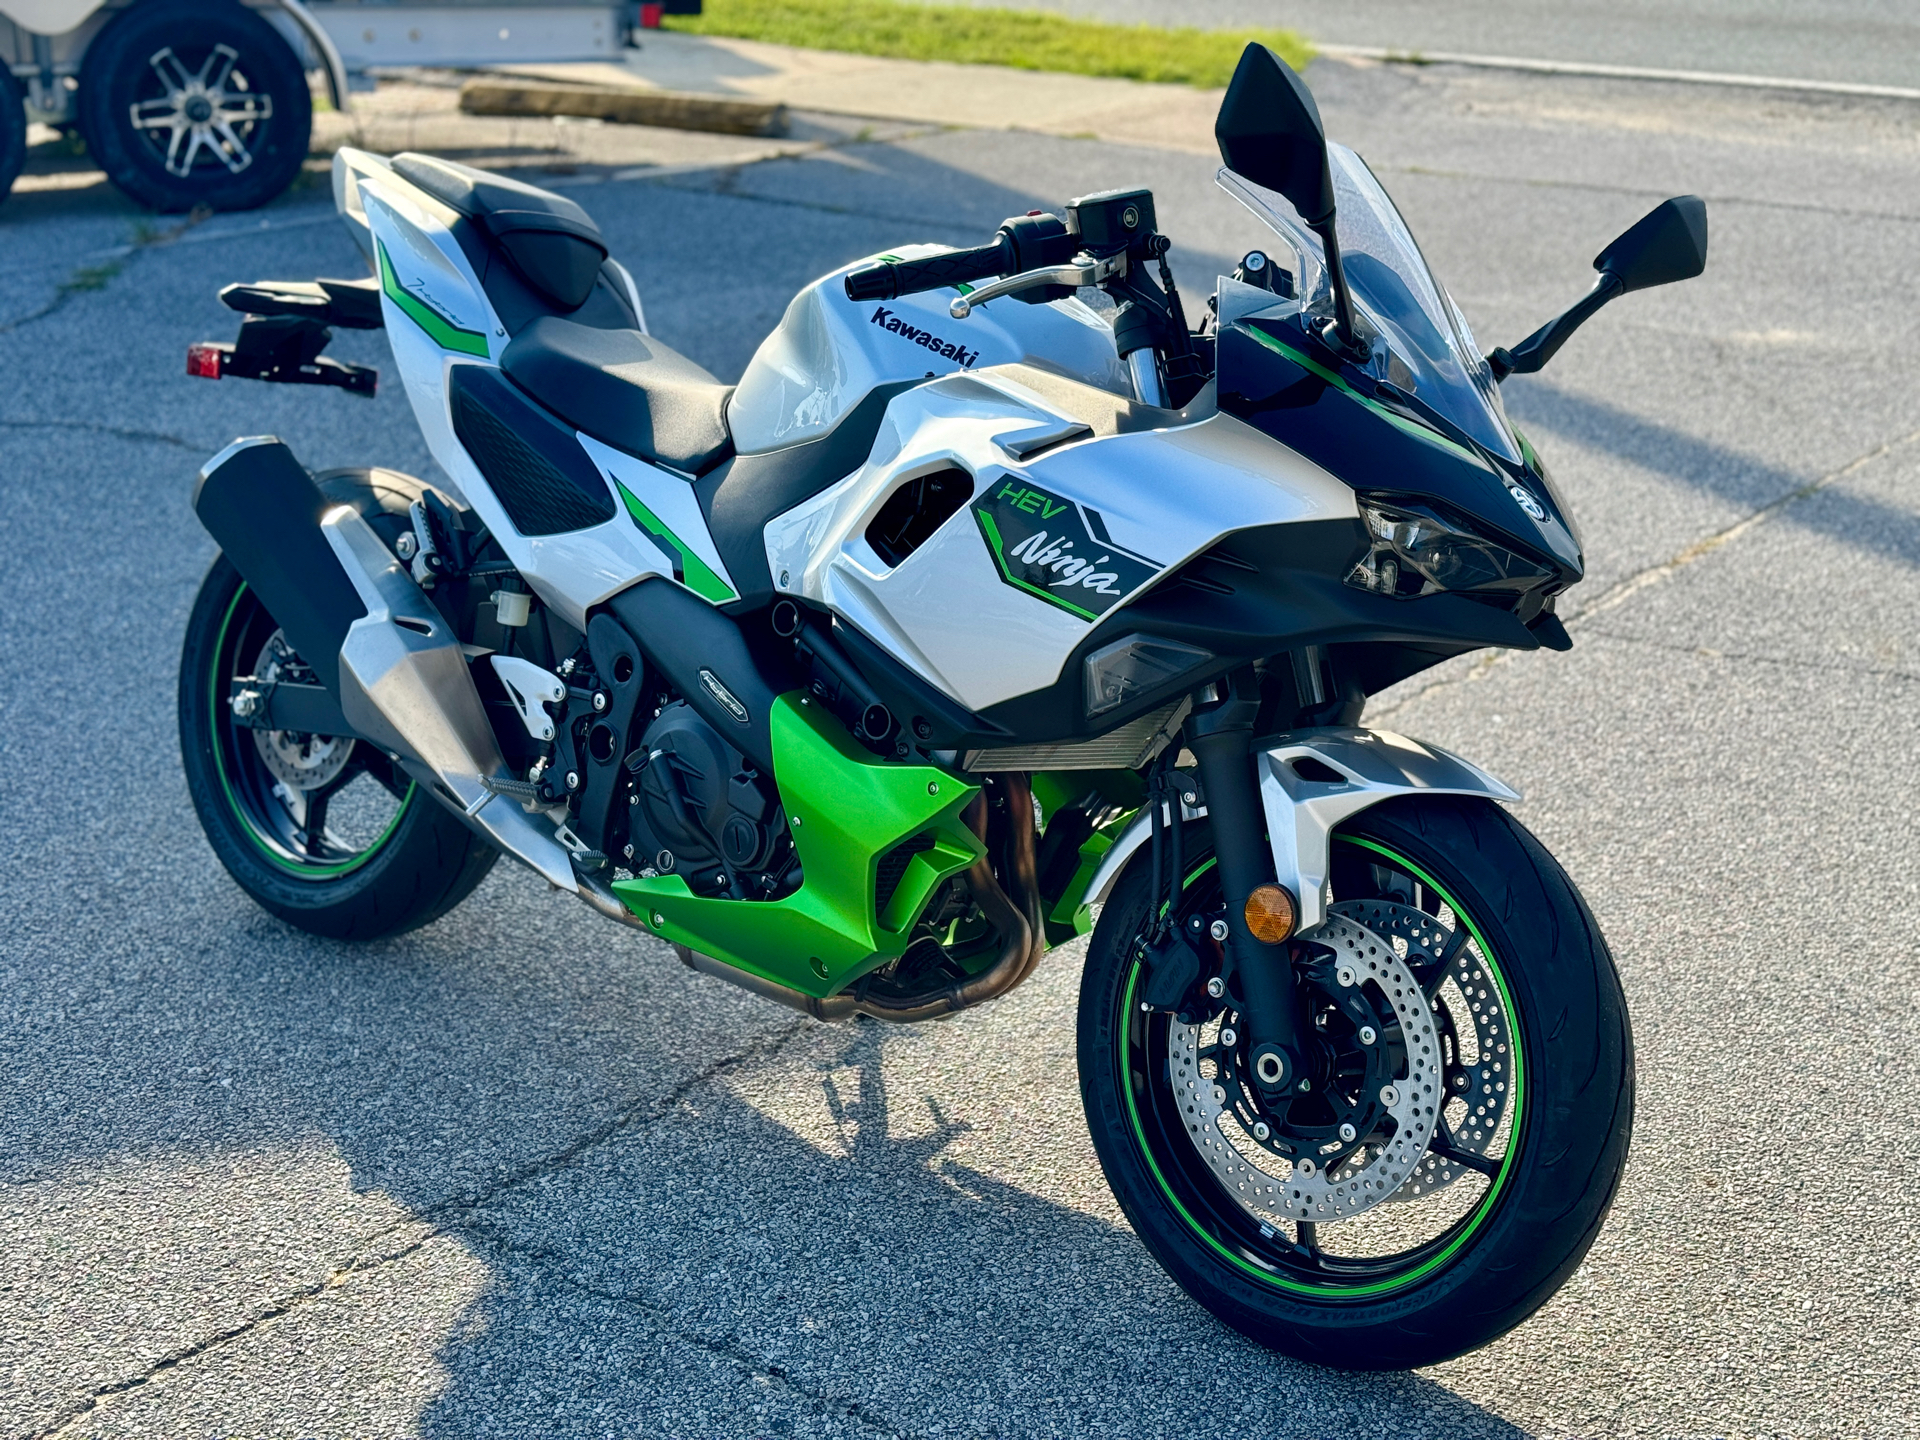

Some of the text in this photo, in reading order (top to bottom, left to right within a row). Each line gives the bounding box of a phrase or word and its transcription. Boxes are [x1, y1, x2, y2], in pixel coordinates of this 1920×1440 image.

[870, 306, 981, 369] Kawasaki
[996, 482, 1068, 520] HEV
[1010, 530, 1121, 596] Ninja
